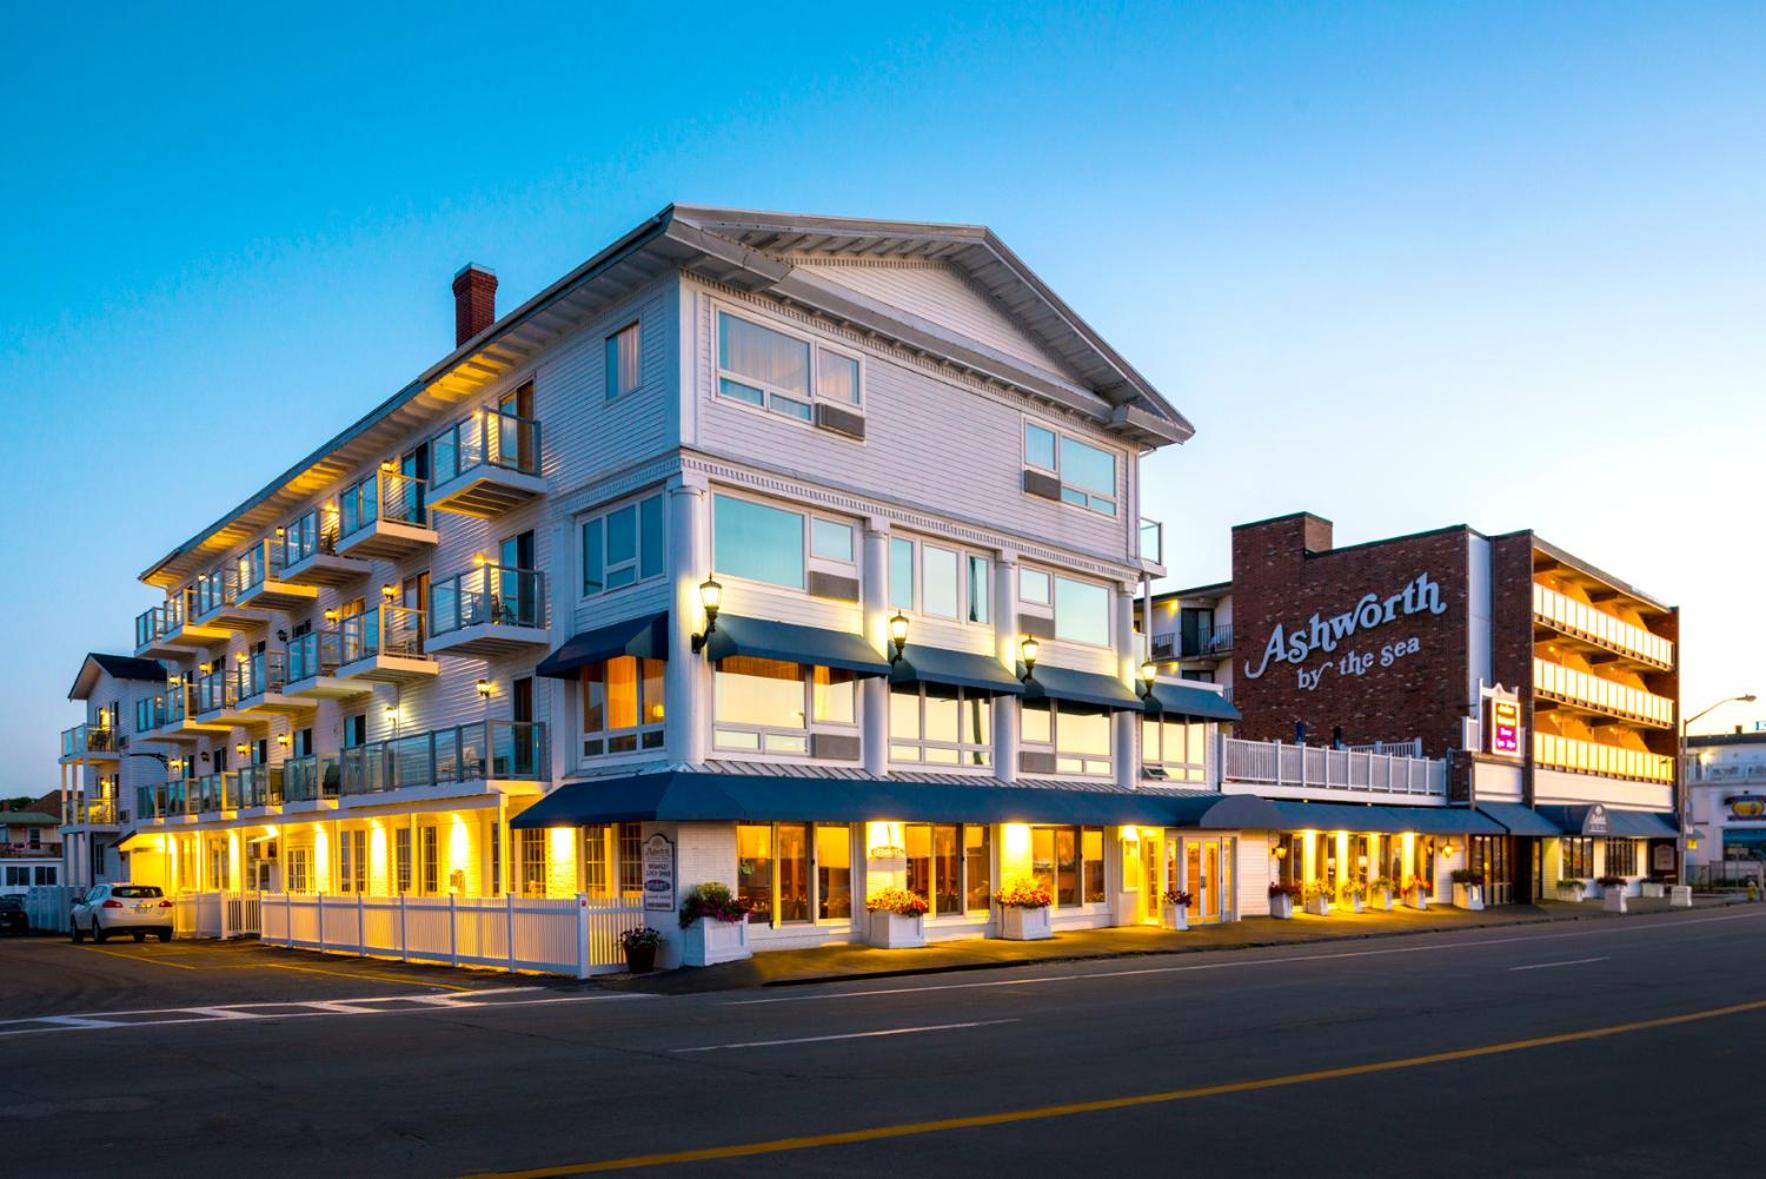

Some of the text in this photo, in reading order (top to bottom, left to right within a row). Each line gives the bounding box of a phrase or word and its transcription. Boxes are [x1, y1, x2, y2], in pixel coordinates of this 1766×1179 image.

[1244, 572, 1447, 679] Ashworth
[1297, 637, 1420, 690] by the sea
